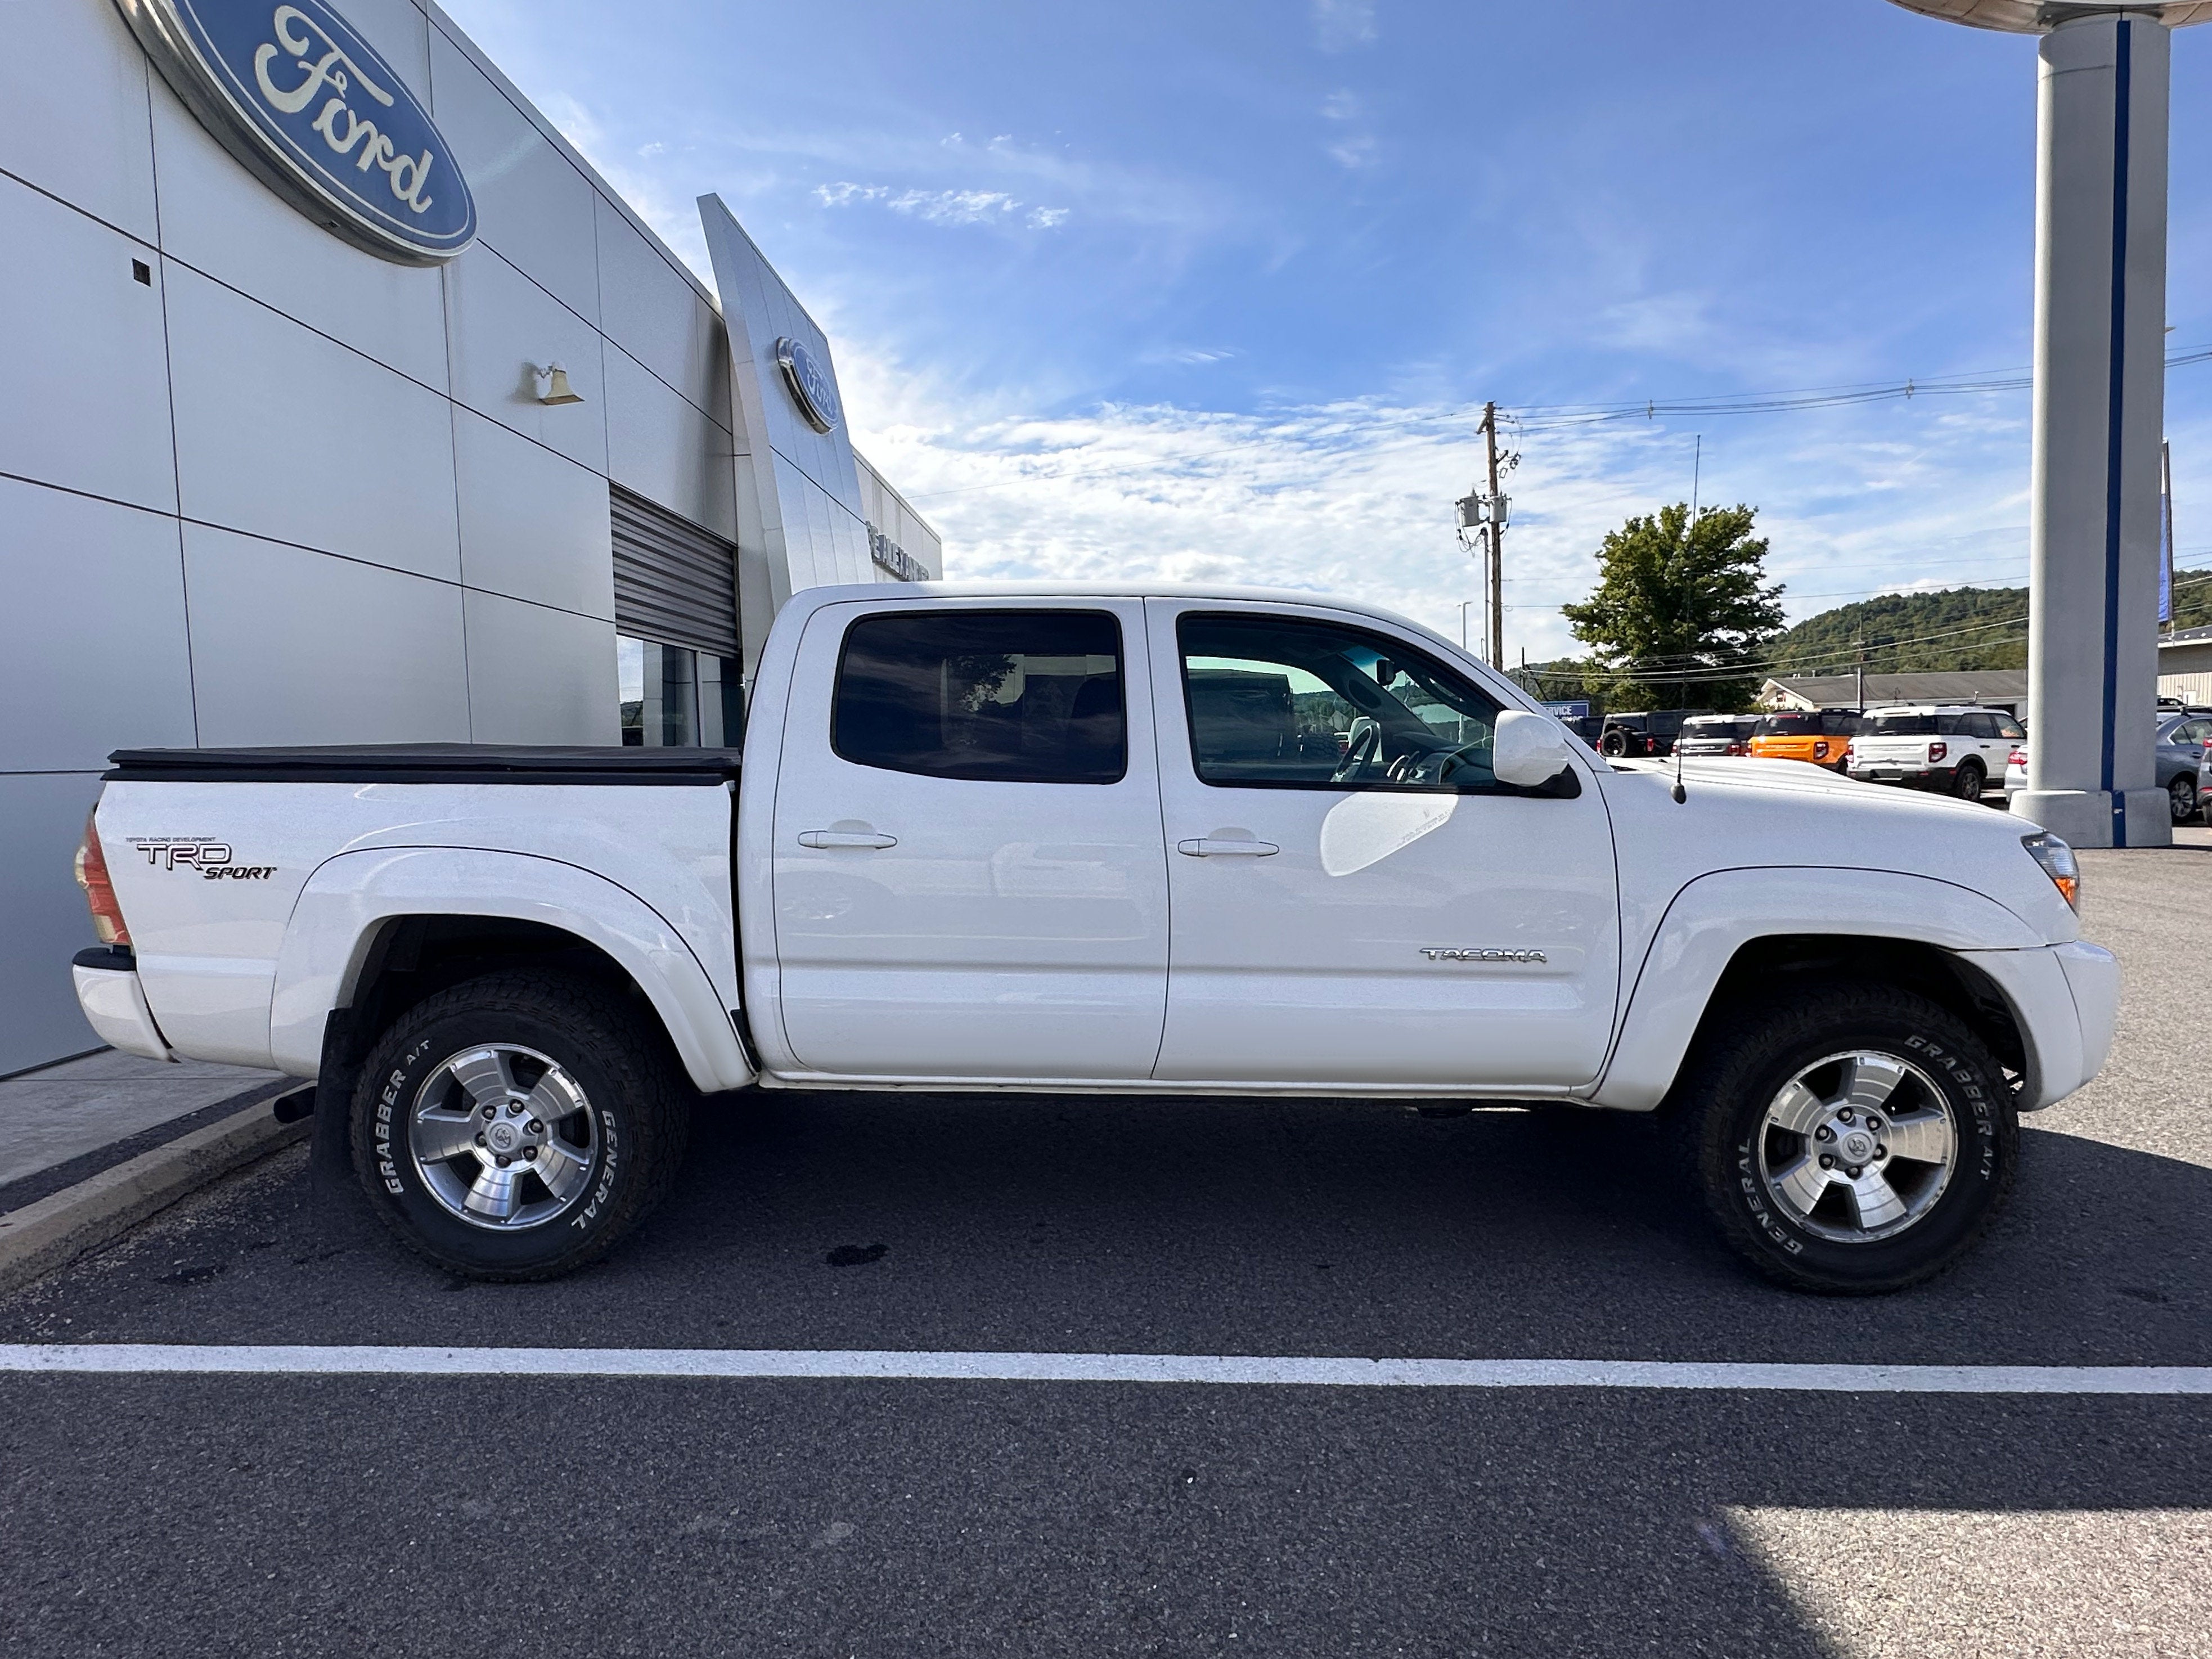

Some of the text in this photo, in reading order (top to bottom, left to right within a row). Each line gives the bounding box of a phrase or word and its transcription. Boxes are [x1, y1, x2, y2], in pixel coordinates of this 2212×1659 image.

[255, 5, 434, 213] Ford
[137, 843, 232, 870] TRD
[203, 867, 277, 879] SPORT
[1419, 947, 1548, 963] TACOMA
[376, 1040, 429, 1194] GRABBER A/T
[1904, 1035, 1993, 1180] GRABBER A/T
[571, 1111, 618, 1229] GENERAL
[1738, 1138, 1804, 1255] GENERAL
